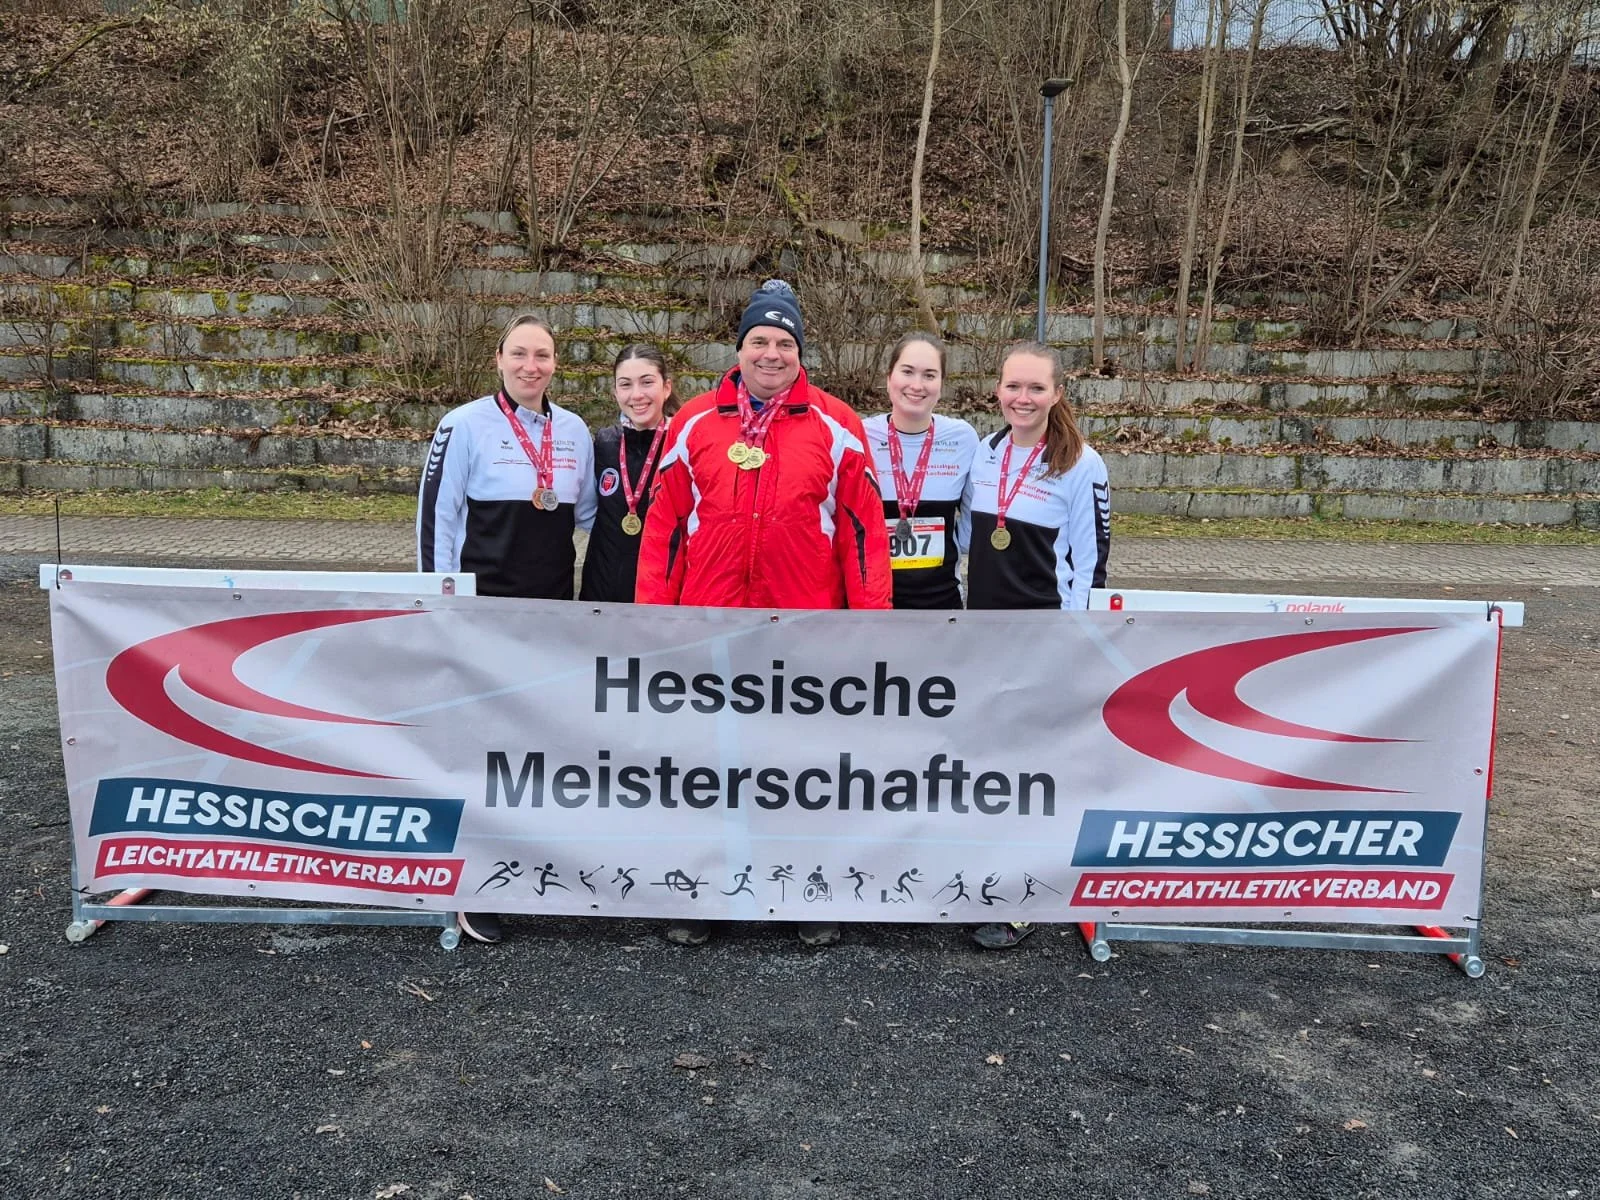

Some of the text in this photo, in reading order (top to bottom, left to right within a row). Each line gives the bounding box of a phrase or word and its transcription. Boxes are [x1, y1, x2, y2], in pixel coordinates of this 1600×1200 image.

[889, 534, 931, 557] 907
[594, 656, 956, 718] Hessische
[485, 750, 1056, 816] Meisterschaften
[125, 786, 431, 843] HESSISCHER
[1106, 820, 1424, 859] HESSISCHER
[104, 845, 452, 887] LEICHTATHLETIK-VERBAND
[1080, 878, 1441, 901] LEICHTATHLETIK-VERBAND
